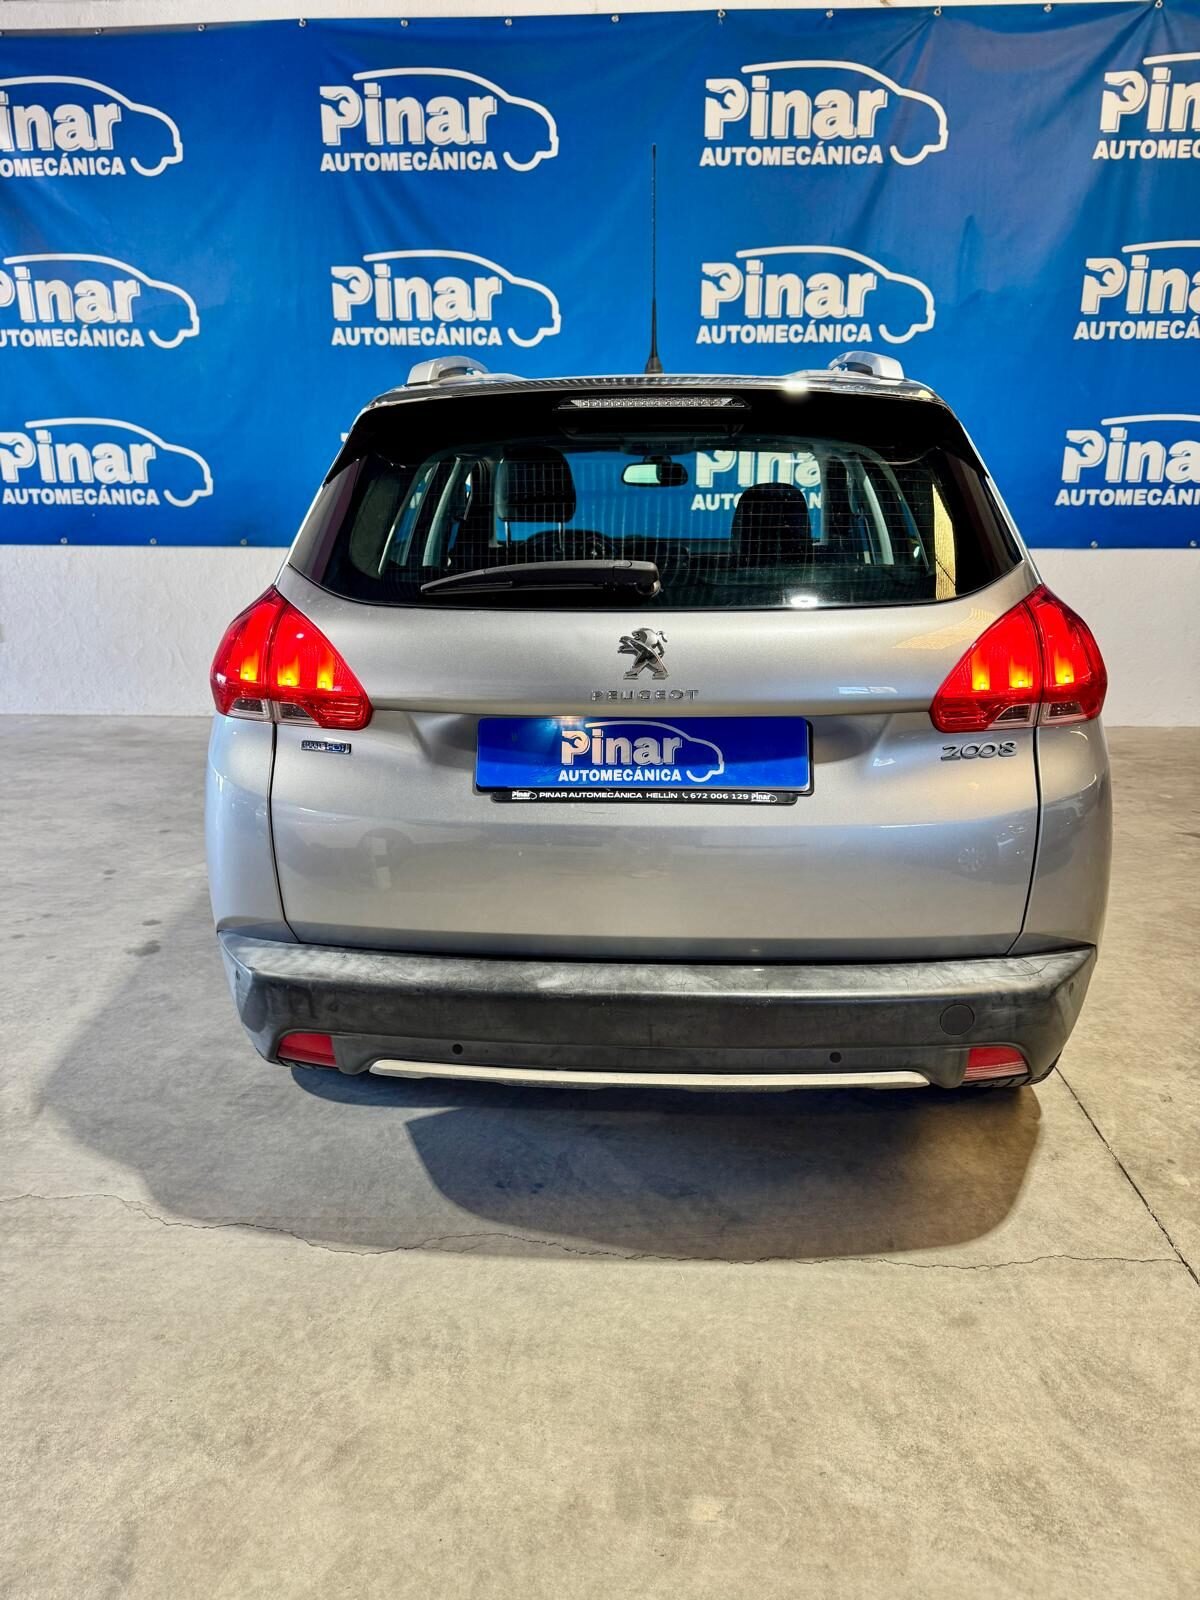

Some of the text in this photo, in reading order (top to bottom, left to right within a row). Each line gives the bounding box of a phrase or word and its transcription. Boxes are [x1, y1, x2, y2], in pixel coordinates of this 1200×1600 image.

[704, 75, 888, 140] Pinar
[1100, 67, 1200, 133] Pin
[0, 90, 122, 152] inar
[319, 82, 498, 146] Pinar
[0, 152, 127, 178] OMECÁNICA
[320, 147, 498, 172] AUTOMECÁNICA
[699, 141, 884, 167] AUTOMECÁNICA
[0, 266, 141, 324] inar
[330, 263, 503, 321] Pinar
[701, 259, 878, 319] Pinar
[1081, 254, 1200, 315] Pin
[0, 324, 145, 348] UTOMECÁNICA
[331, 323, 503, 346] AUTOMECÁNICA
[696, 320, 873, 344] AUTOMECÁNICA
[1073, 316, 1200, 340] AUTOMECÁ
[0, 429, 157, 484] Pinar
[1061, 427, 1200, 484] Pina
[696, 450, 821, 488] Pina
[2, 485, 160, 505] AUTOMECÁNICA
[1054, 484, 1200, 506] AUTOMECÁNI
[591, 688, 700, 701] PEUGEOT
[561, 729, 683, 766] Pinar
[940, 741, 1017, 761] 2008
[558, 766, 682, 782] AUTOMECÁNICA
[568, 790, 643, 799] AUTOMECÁNICA
